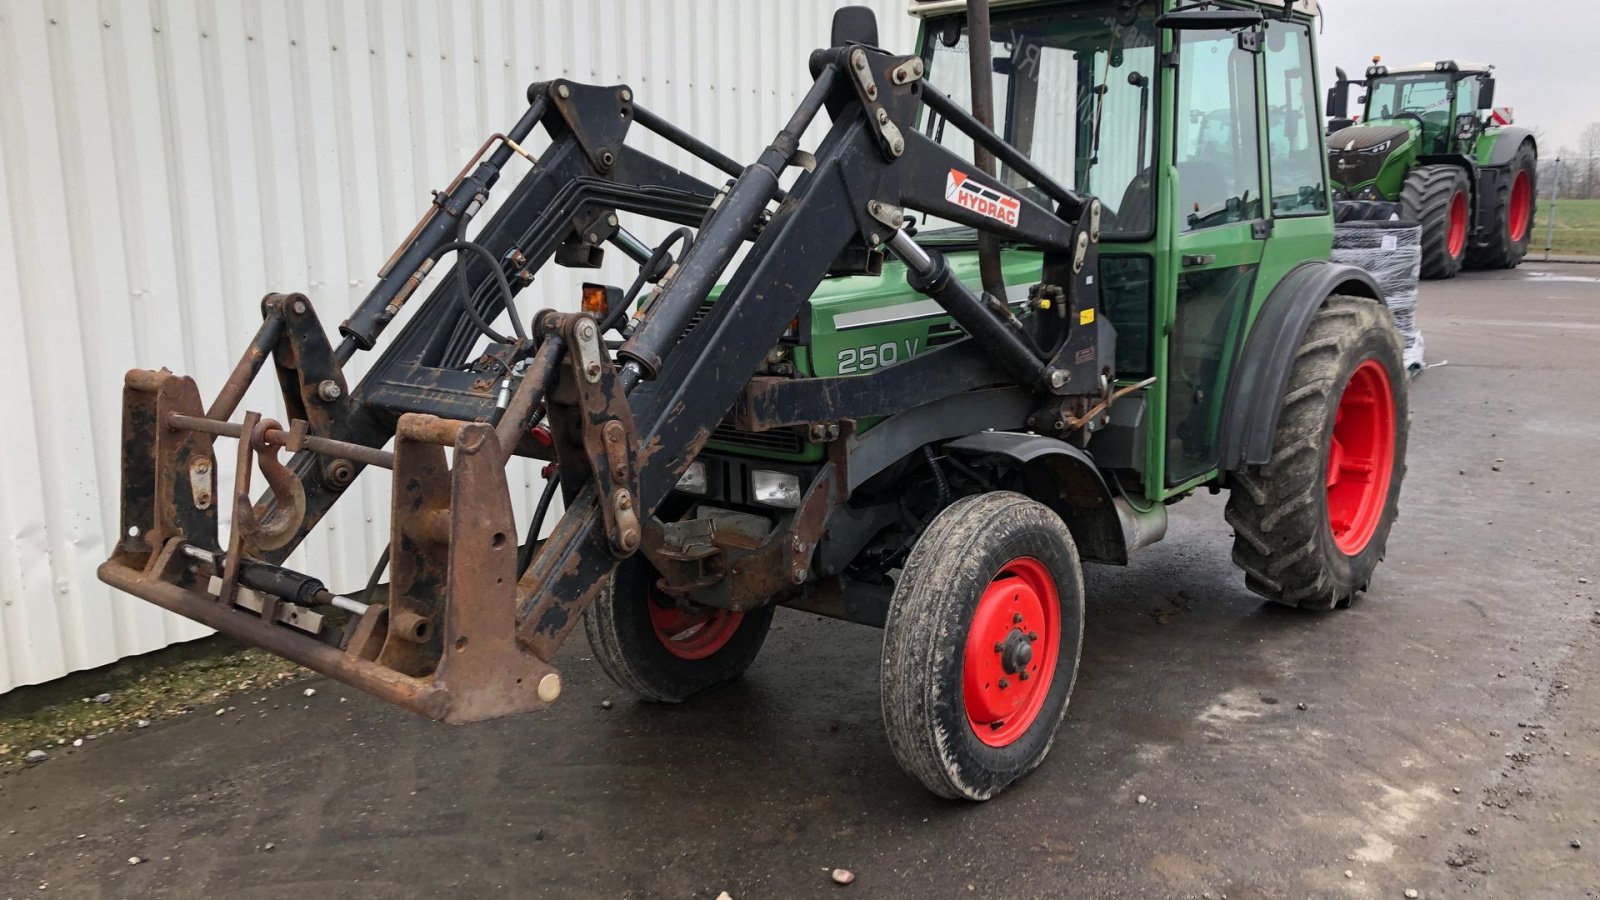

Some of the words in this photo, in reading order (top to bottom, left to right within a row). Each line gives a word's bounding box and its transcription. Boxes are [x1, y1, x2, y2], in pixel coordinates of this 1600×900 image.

[957, 189, 1015, 224] HYDRAC
[838, 341, 898, 375] 250
[904, 337, 920, 359] V
